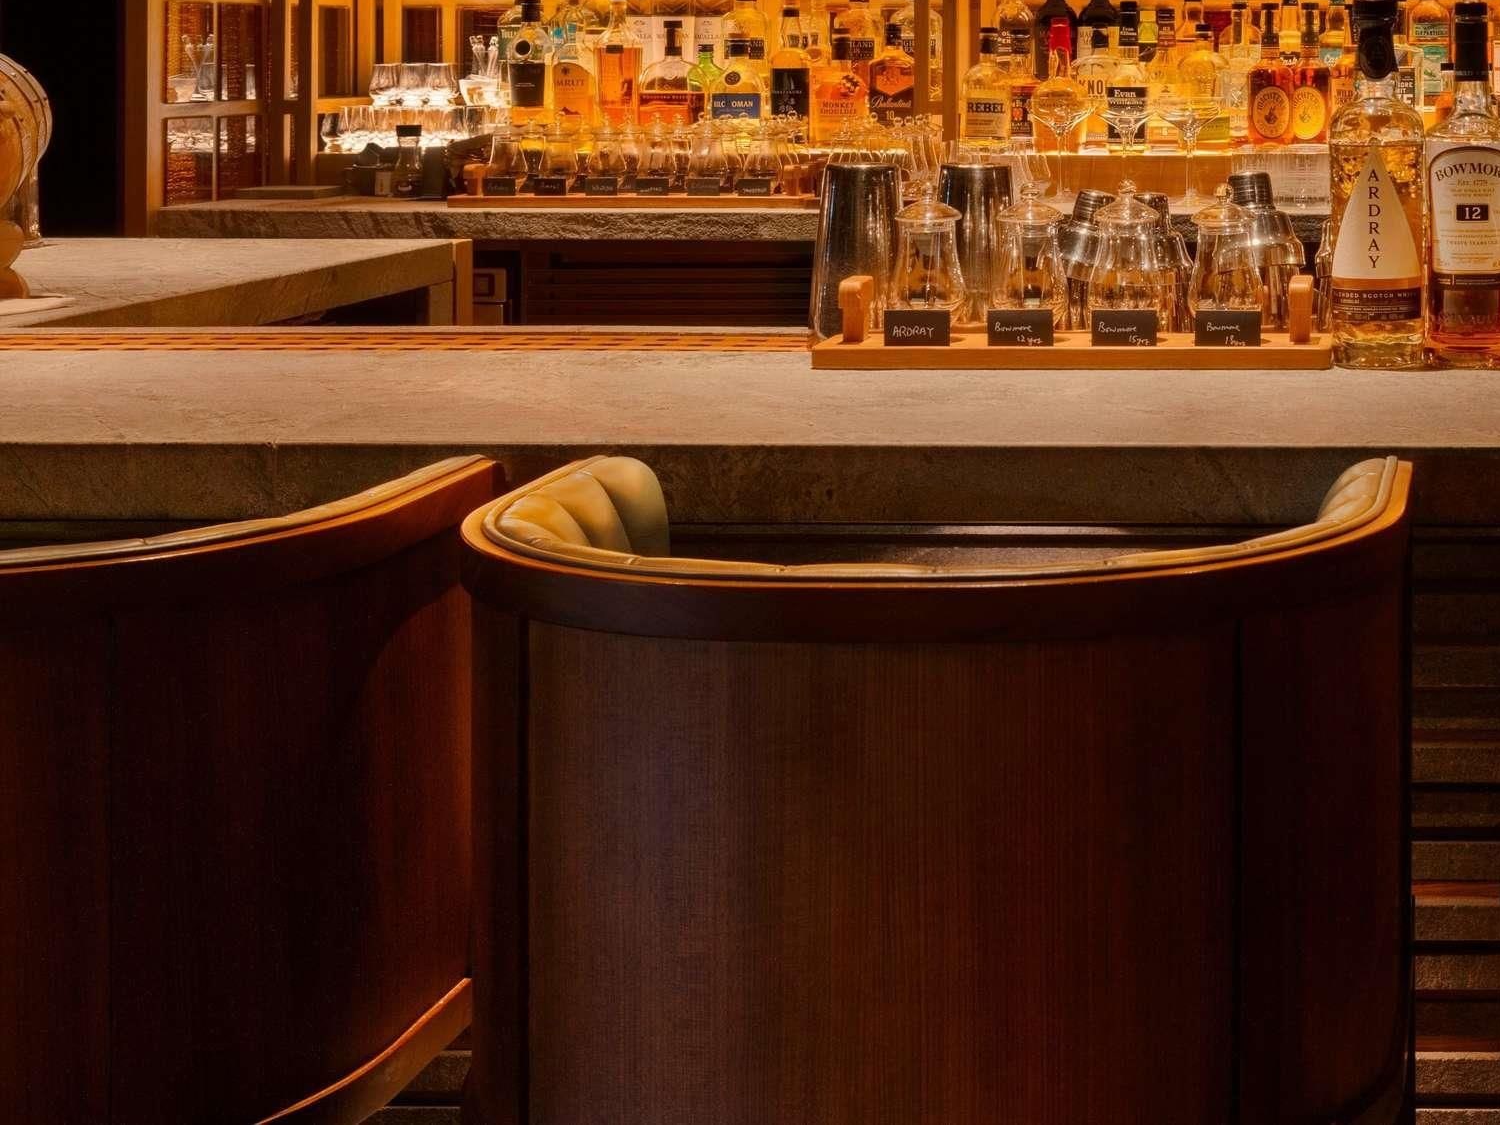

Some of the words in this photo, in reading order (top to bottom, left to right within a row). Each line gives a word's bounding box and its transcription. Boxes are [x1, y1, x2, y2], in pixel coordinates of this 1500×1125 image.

[1114, 89, 1137, 98] Evan
[967, 101, 1005, 114] REBEL
[1367, 168, 1382, 269] ARDRAY
[1464, 207, 1481, 220] 12
[892, 325, 934, 339] ARDRAY
